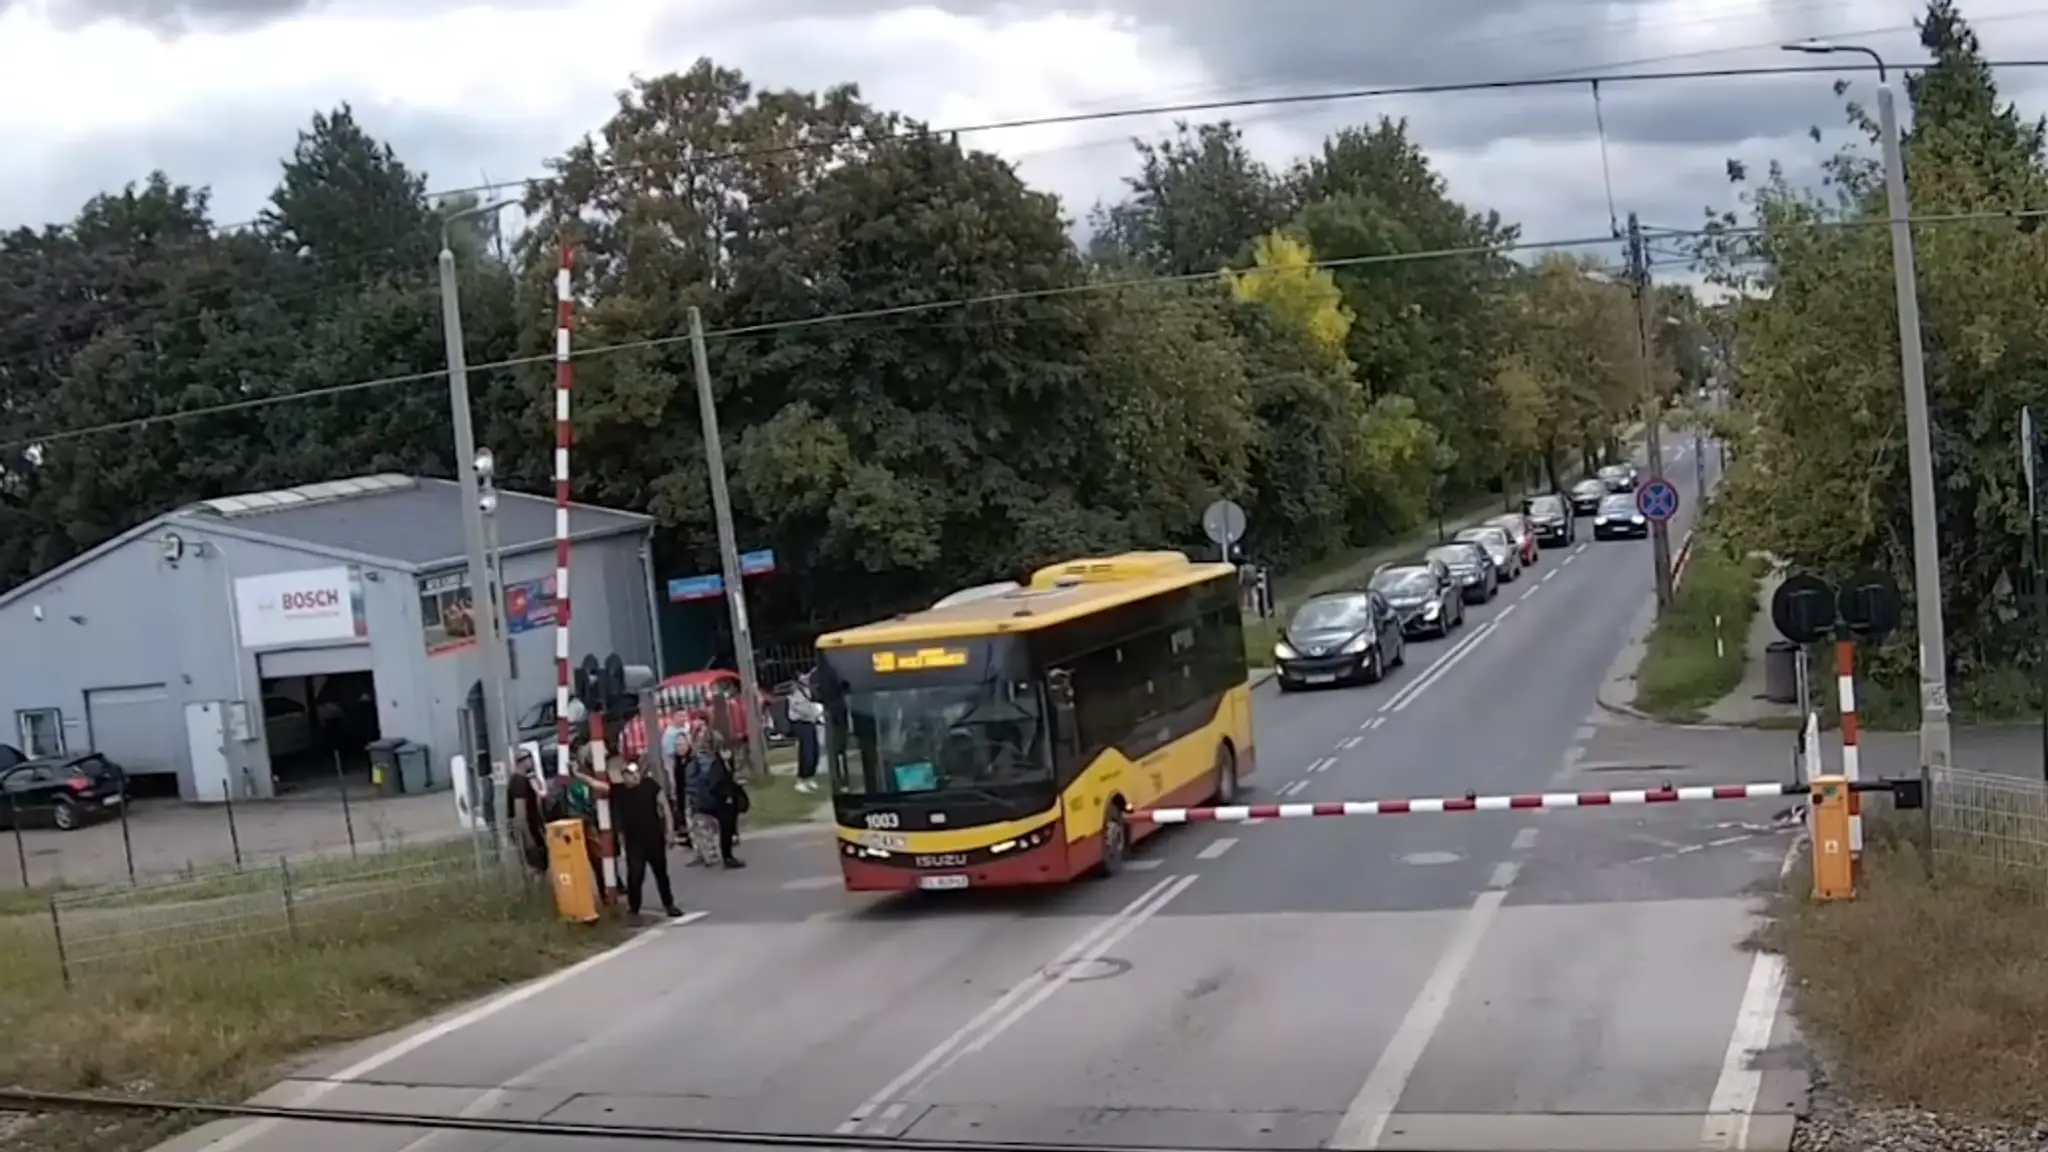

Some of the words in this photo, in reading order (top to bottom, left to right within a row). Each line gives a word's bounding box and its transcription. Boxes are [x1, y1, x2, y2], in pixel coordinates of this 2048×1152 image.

[282, 588, 339, 610] BOSCH
[865, 812, 899, 829] 1003
[915, 854, 968, 867] ISUZU
